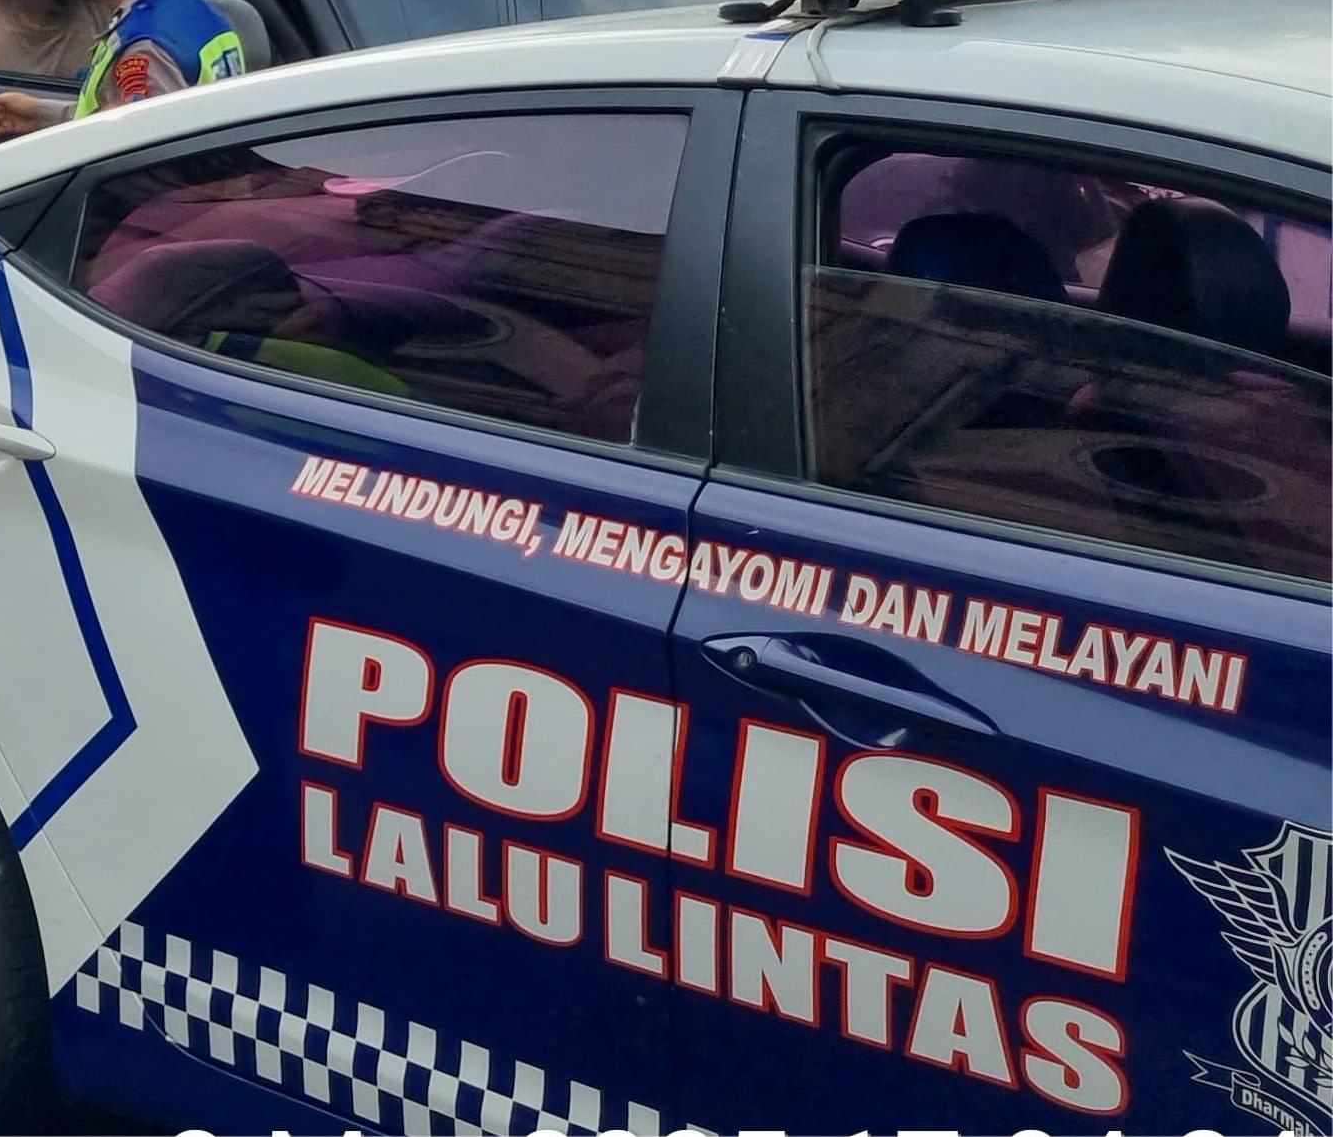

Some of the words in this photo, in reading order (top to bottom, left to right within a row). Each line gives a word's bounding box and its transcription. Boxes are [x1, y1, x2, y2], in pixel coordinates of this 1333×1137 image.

[290, 454, 545, 560] MELINDUNGI,
[551, 510, 833, 618] MENGAYOMI
[838, 571, 953, 646] DAN
[956, 596, 1249, 716] MELAYANI
[299, 616, 1140, 983] POLISI
[300, 779, 584, 947] LALU
[603, 868, 1130, 1117] LINTAS
